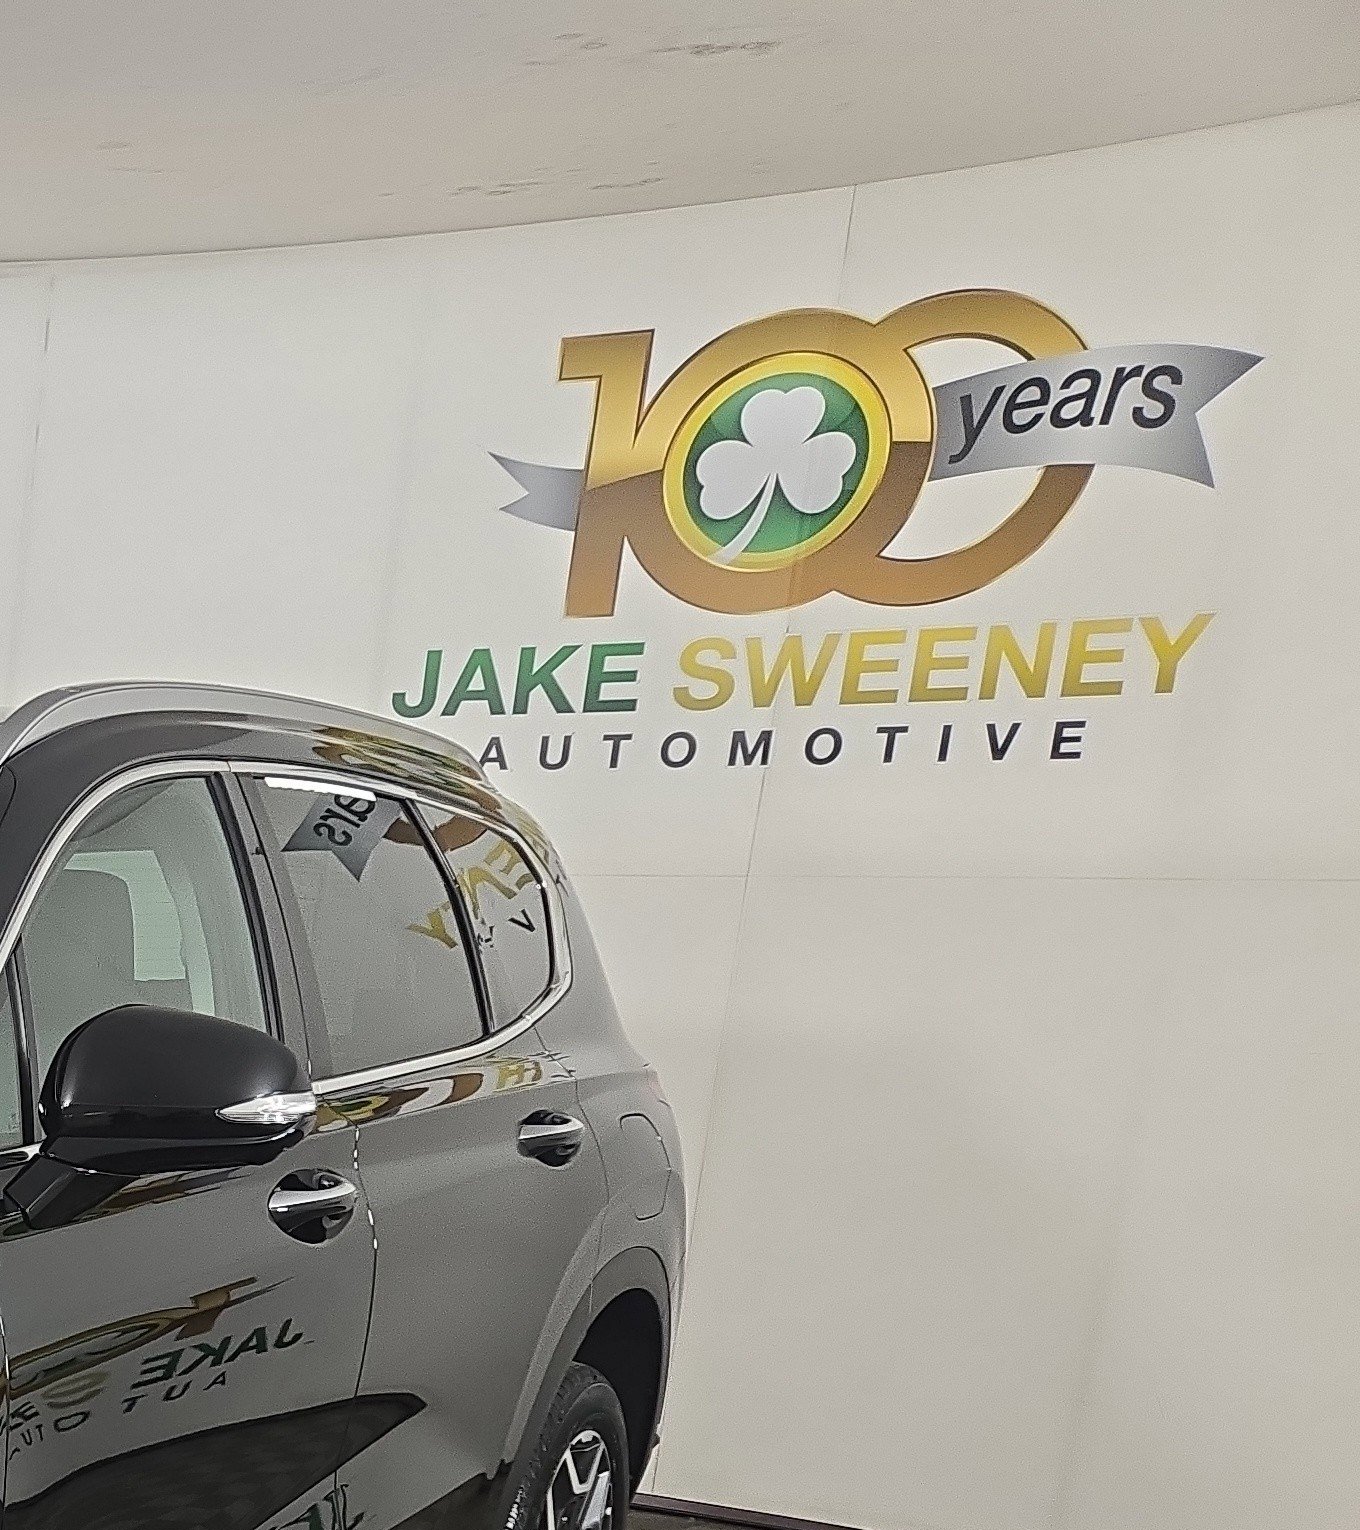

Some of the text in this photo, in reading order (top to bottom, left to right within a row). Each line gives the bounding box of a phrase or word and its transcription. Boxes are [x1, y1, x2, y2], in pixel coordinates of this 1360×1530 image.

[558, 288, 1182, 618] 100 years
[391, 612, 1218, 718] JAKE SWEENEY
[479, 720, 1088, 770] AUTOMOTIVE
